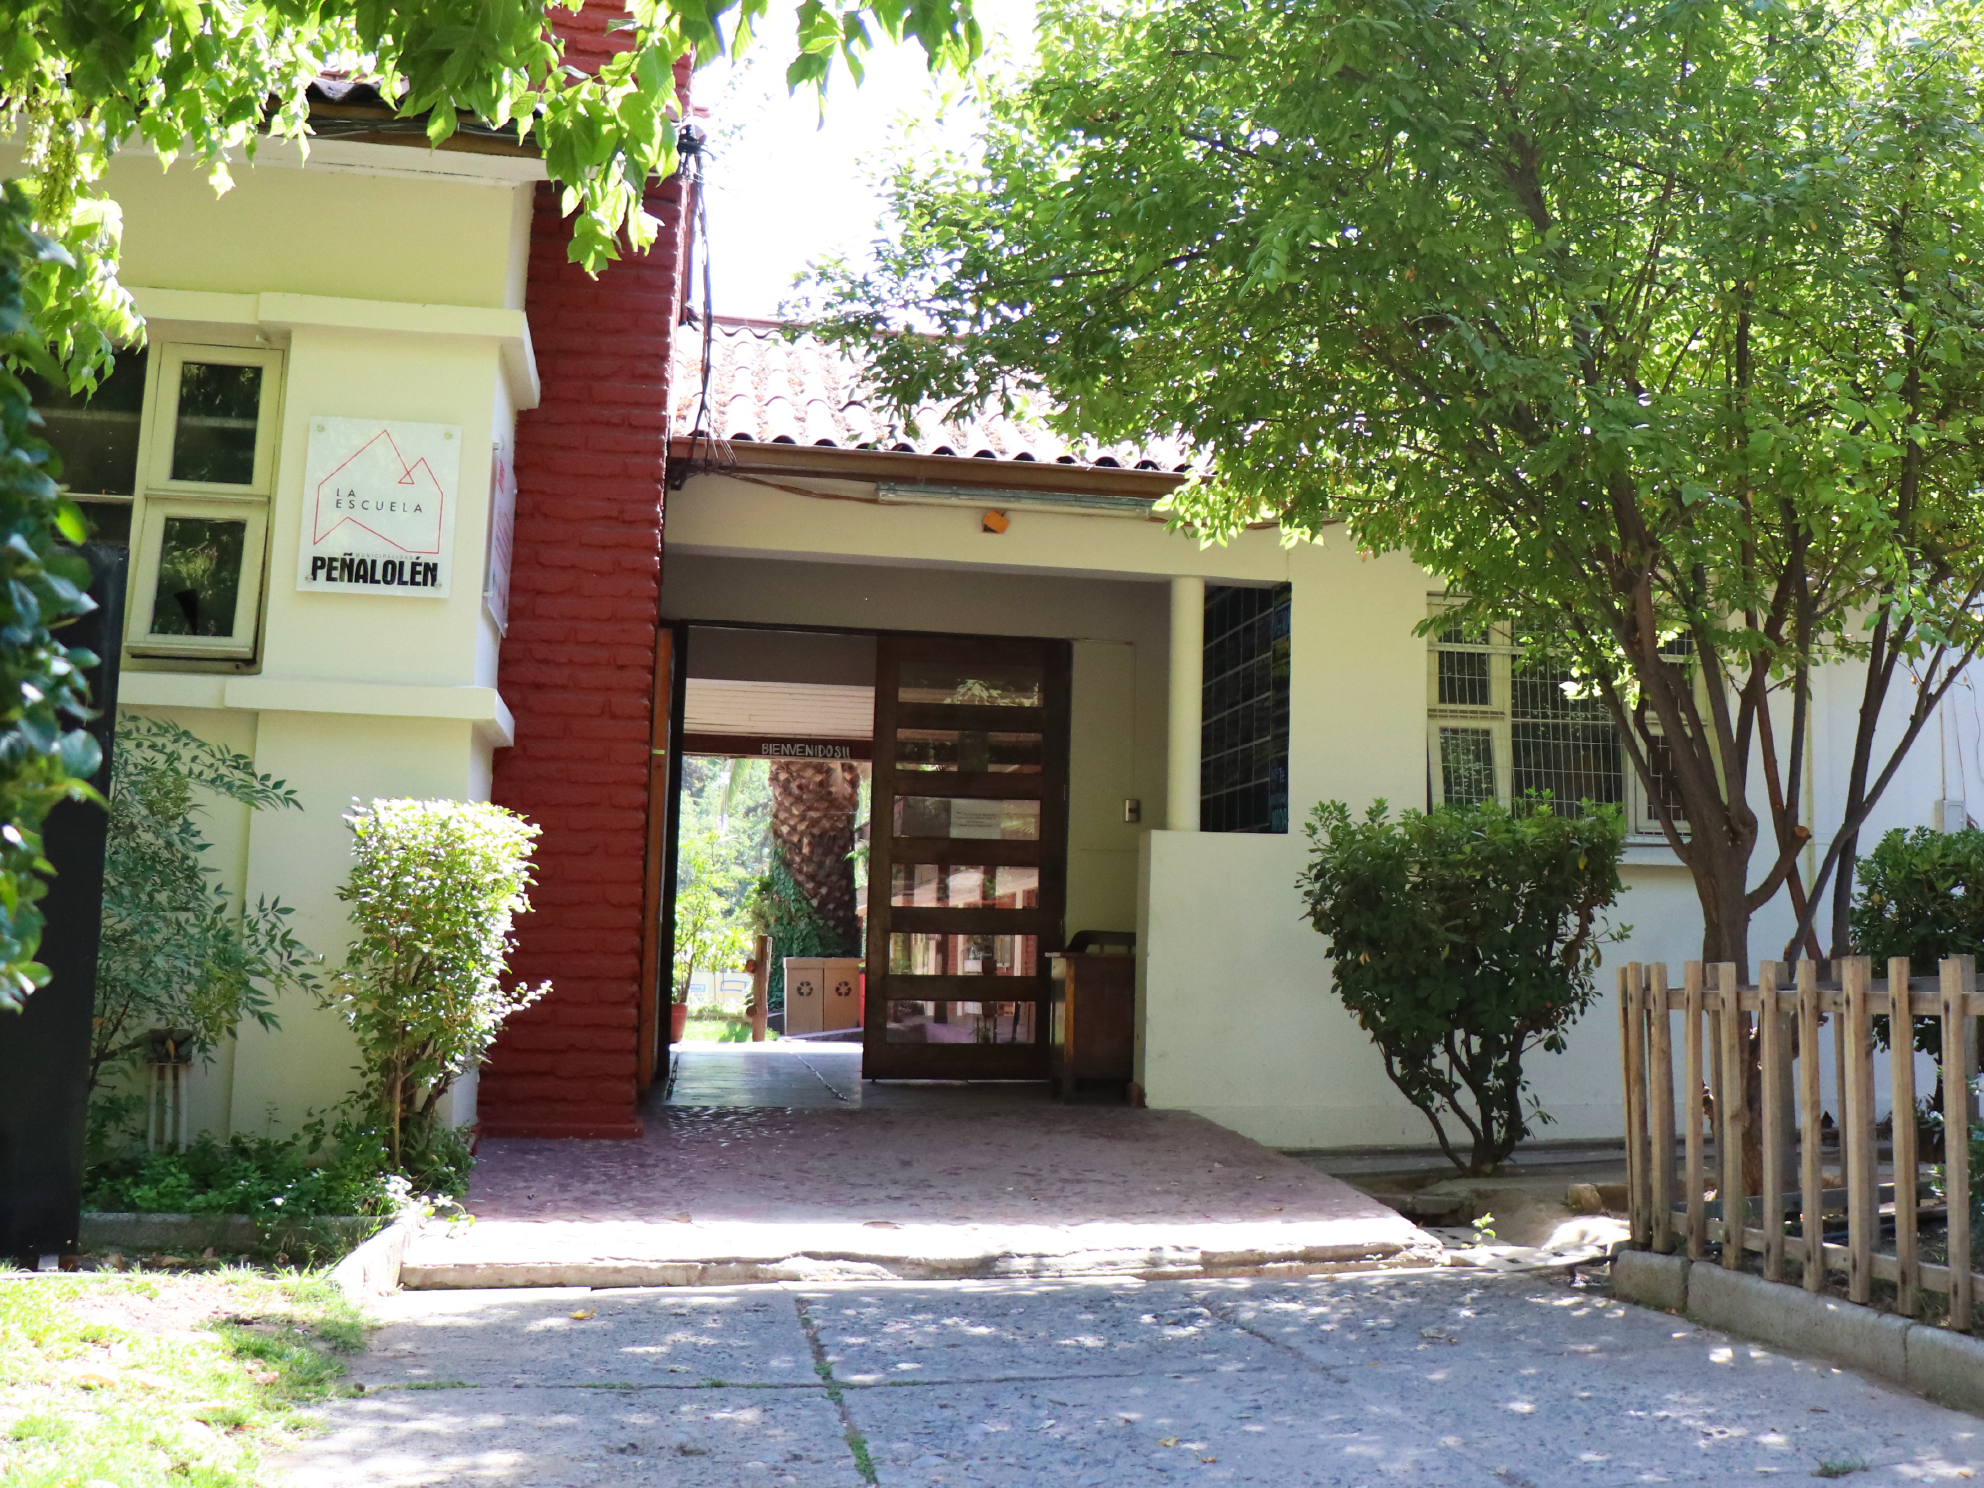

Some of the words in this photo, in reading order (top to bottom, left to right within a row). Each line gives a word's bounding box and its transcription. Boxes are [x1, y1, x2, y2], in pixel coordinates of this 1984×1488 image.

[336, 488, 356, 498] LA
[335, 498, 423, 513] ESCUELA
[355, 552, 414, 561] MUNICIPALIDAD
[310, 552, 439, 587] PEÑALOLÉN
